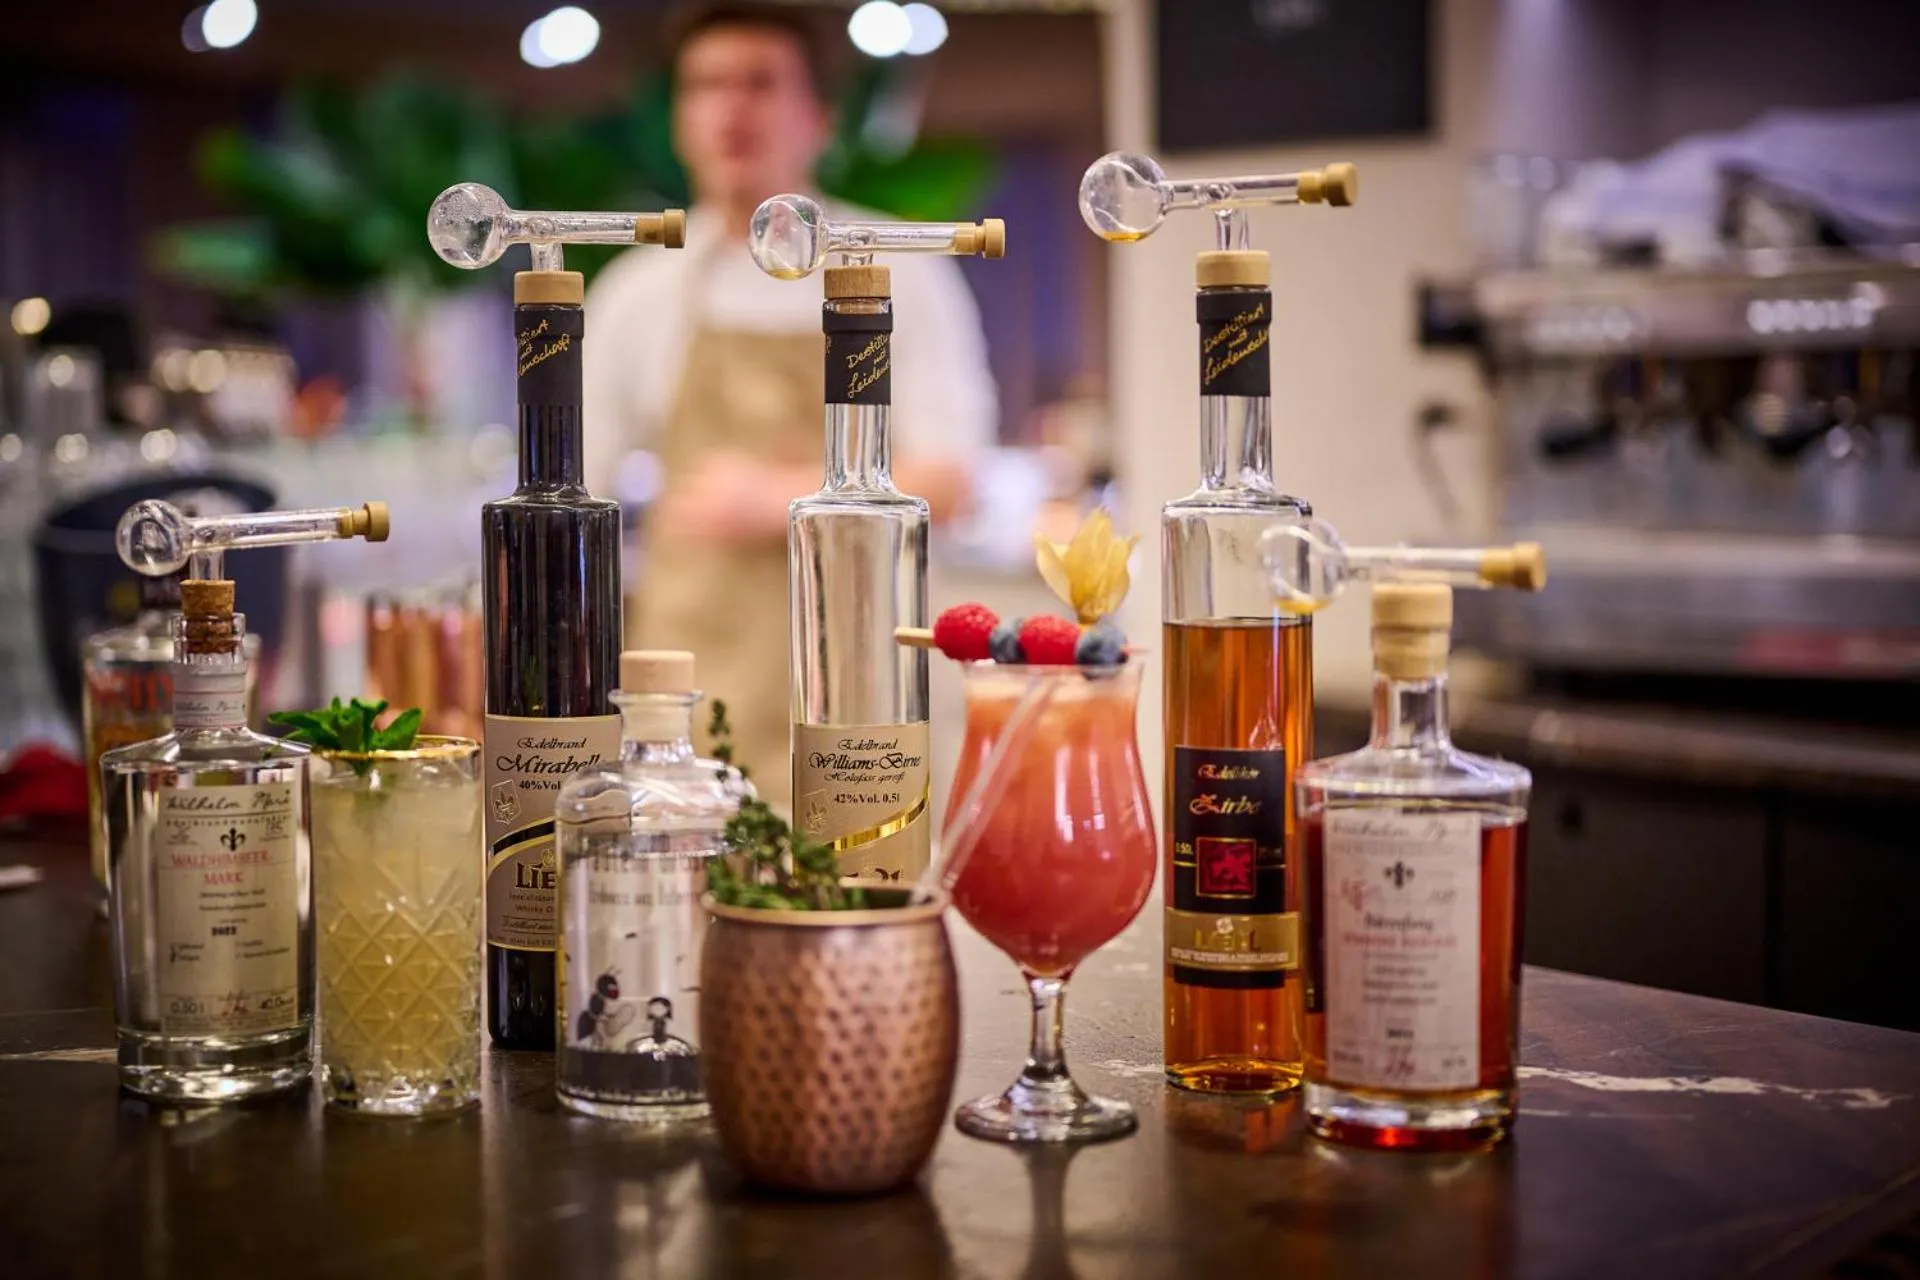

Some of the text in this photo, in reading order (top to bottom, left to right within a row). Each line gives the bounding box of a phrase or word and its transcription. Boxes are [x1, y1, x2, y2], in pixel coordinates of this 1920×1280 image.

[516, 737, 588, 750] Edelbrand
[837, 738, 899, 751] Edelbrand
[808, 751, 922, 771] Williams-Birne
